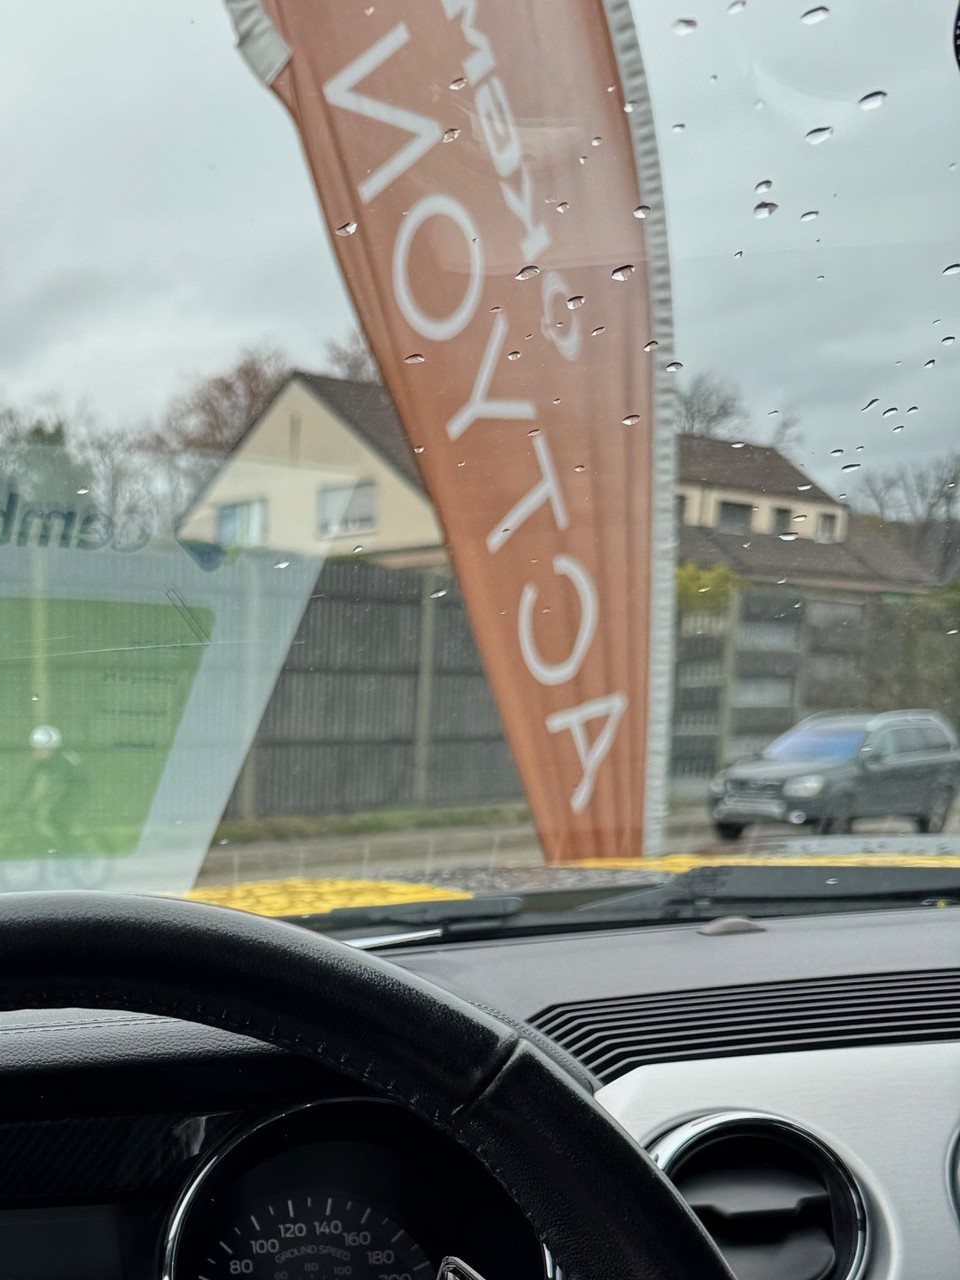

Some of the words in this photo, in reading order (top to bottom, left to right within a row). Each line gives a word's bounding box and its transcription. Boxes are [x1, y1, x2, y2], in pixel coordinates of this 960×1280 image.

[278, 1223, 306, 1238] 120
[312, 1220, 342, 1235] 140
[250, 1239, 279, 1254] 100
[342, 1231, 371, 1247] 160
[275, 1245, 317, 1264] GROUND
[318, 1244, 351, 1261] SPEED
[366, 1249, 394, 1265] 180
[229, 1259, 253, 1274] 80
